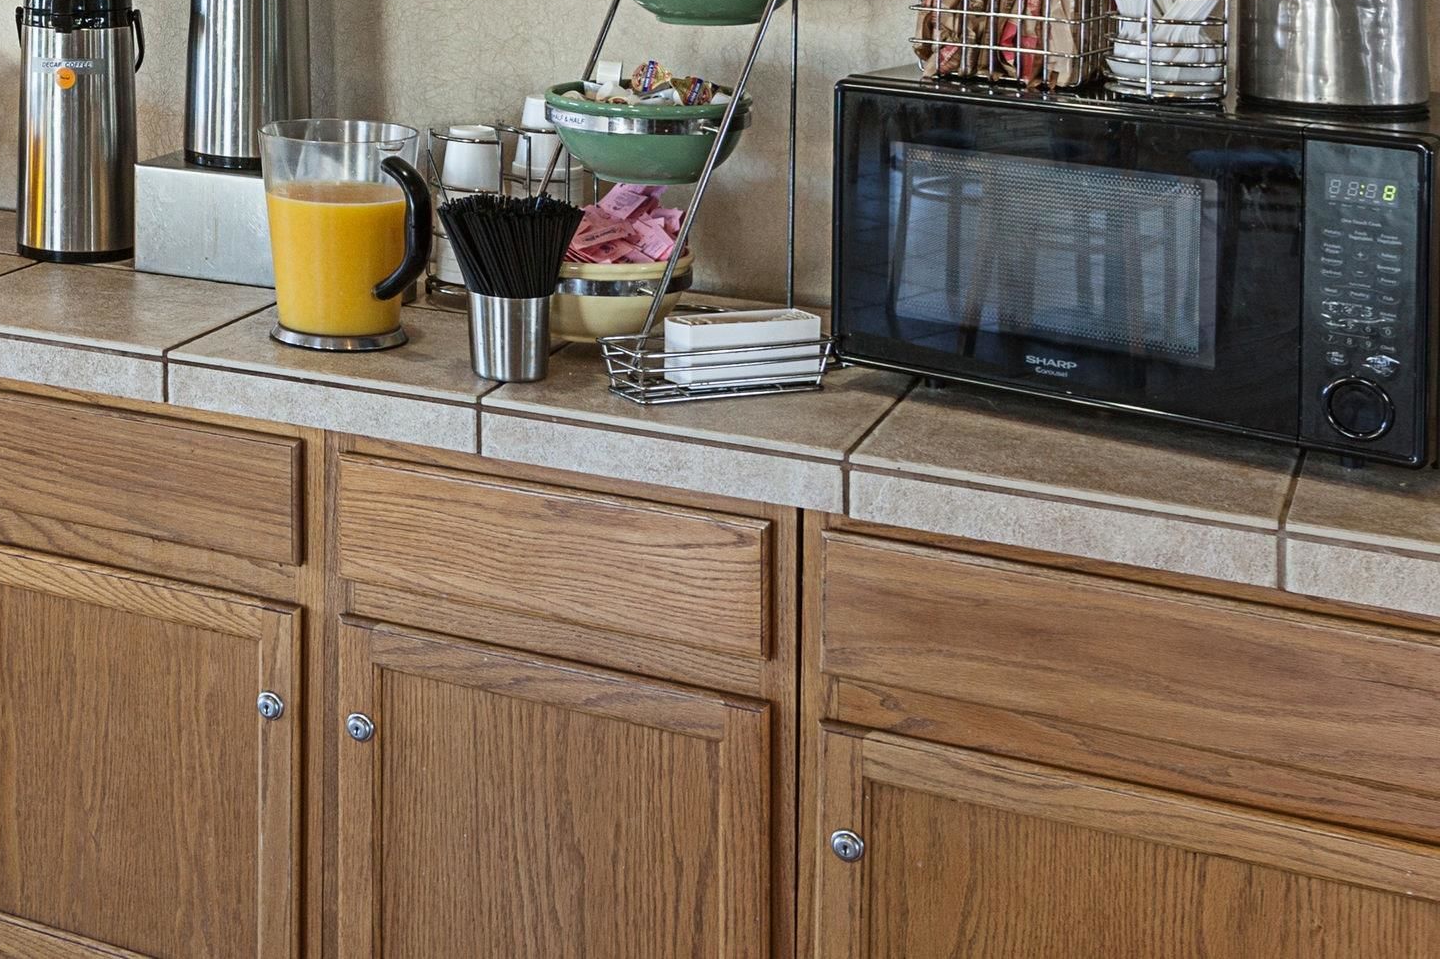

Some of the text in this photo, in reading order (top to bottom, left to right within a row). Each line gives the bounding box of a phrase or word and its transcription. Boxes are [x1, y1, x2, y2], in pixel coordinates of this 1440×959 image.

[570, 117, 585, 125] HALF
[1025, 355, 1078, 369] SHARP
[1035, 366, 1068, 378] Carousel
